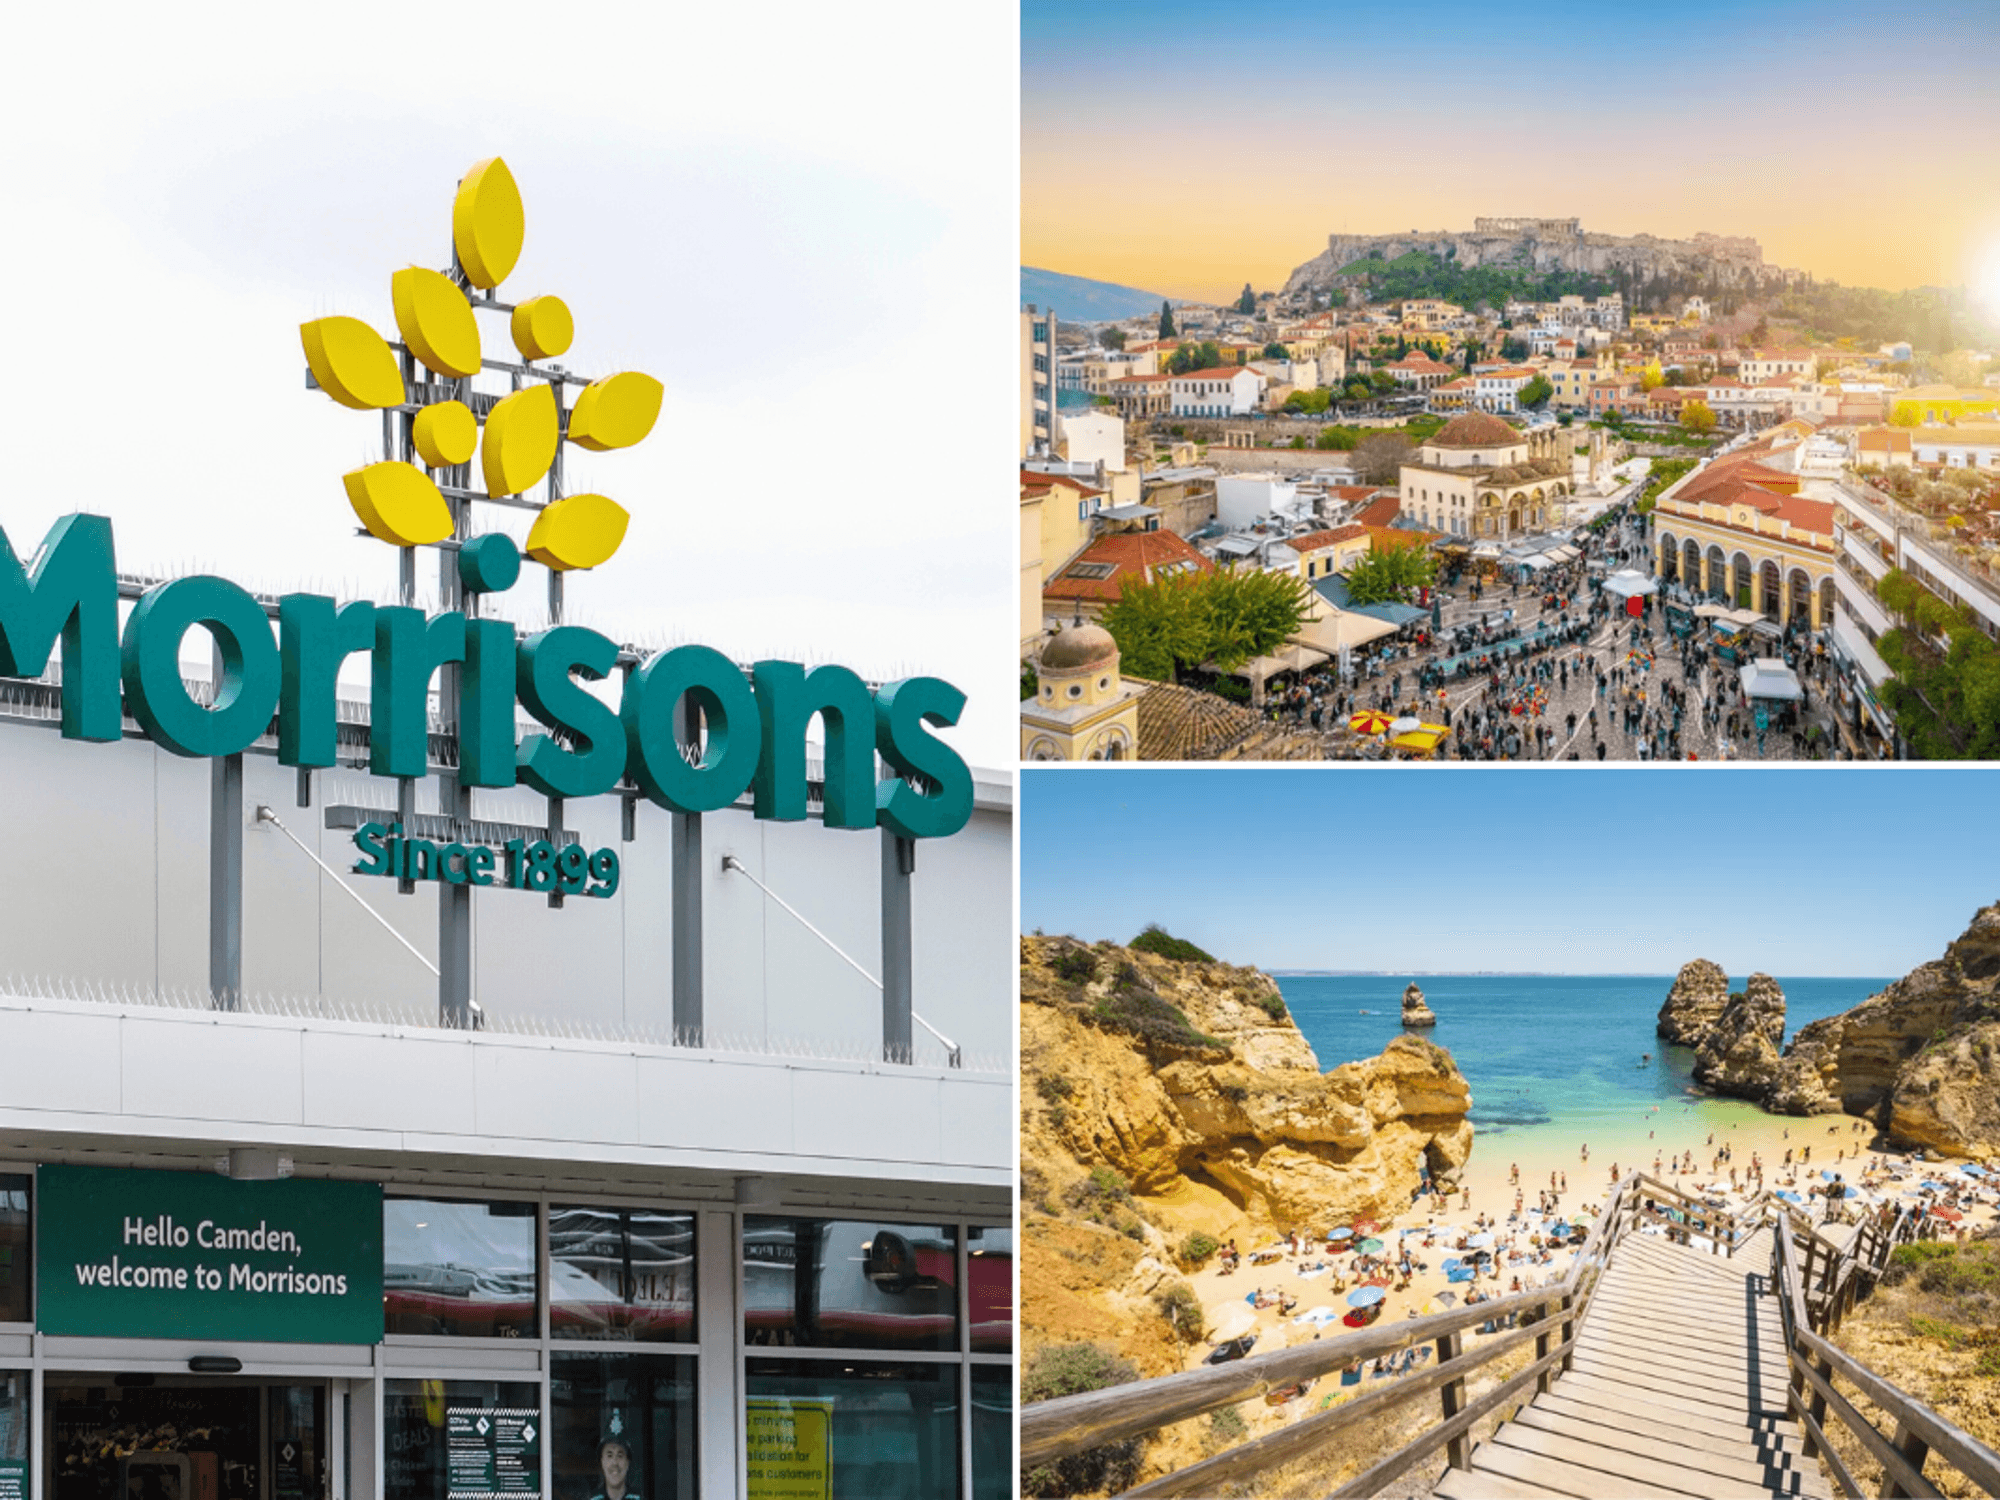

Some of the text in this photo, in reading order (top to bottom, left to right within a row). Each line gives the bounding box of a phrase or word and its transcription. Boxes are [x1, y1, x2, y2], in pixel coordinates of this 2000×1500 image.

[0, 511, 974, 839] Morrisons
[352, 821, 620, 898] Since 1899
[123, 1214, 302, 1258] Hello Camden,
[75, 1254, 348, 1296] welcome to Morrisons
[747, 1449, 810, 1462] alidation for
[766, 1467, 823, 1480] customers
